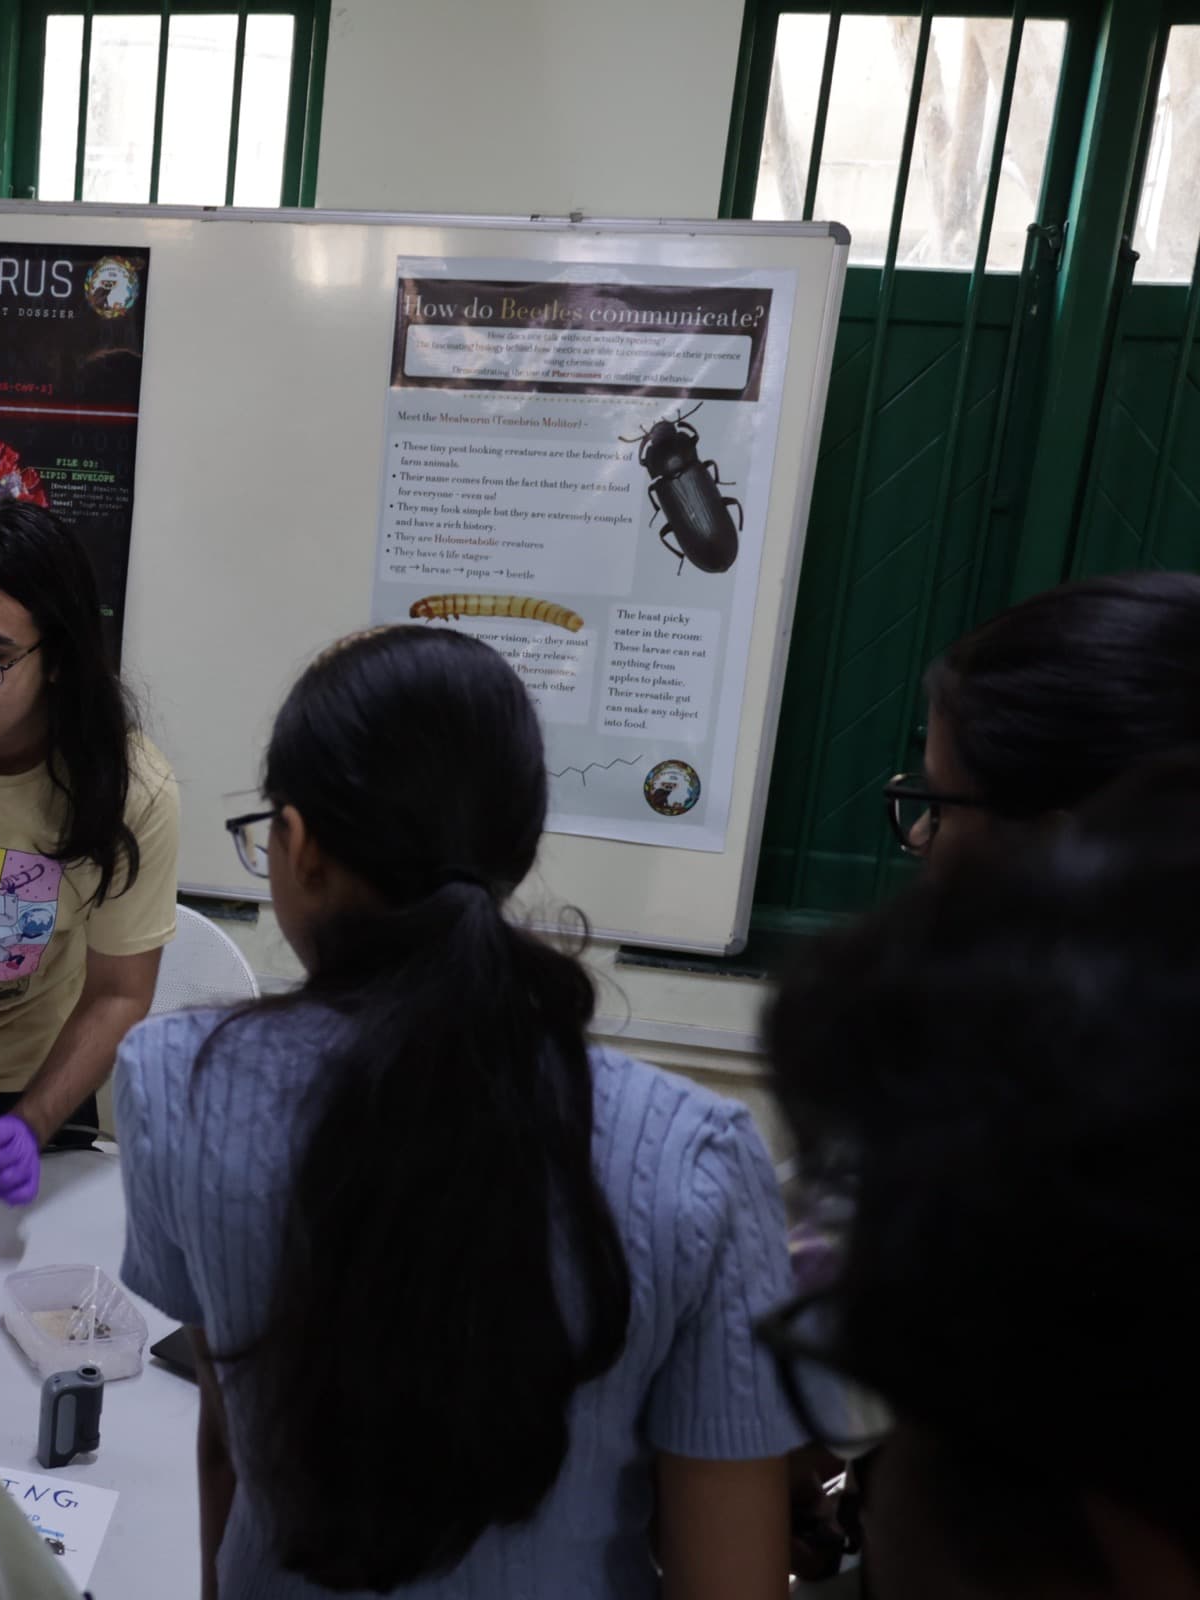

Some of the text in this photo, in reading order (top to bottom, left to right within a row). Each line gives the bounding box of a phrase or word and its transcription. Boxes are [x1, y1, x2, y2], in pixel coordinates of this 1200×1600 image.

[19, 307, 75, 319] DOSSIER
[405, 295, 764, 328] How do Beetles communicate?
[398, 410, 420, 421] Meet
[422, 412, 437, 422] the
[439, 413, 490, 424] Mealworm
[402, 441, 428, 450] These
[430, 444, 447, 455] tiny
[449, 446, 467, 455] pest
[470, 445, 503, 458] looking
[505, 448, 548, 457] creatures
[566, 450, 581, 458] the
[56, 458, 79, 467] FILE
[400, 456, 422, 465] farm
[40, 471, 116, 483] LIPID ENVELOPE
[400, 472, 424, 481] Their
[426, 475, 450, 483] name
[482, 476, 504, 486] from
[506, 477, 520, 486] the
[521, 477, 538, 487] fact
[540, 479, 558, 489] that
[560, 480, 578, 492] they
[608, 482, 631, 493] food
[398, 487, 411, 496] for
[413, 490, 453, 500] everyone
[397, 502, 418, 514] They
[420, 505, 438, 515] may
[440, 504, 460, 514] look
[462, 506, 492, 517] simple
[494, 507, 508, 517] but
[510, 508, 529, 520] they
[547, 512, 592, 524] extremely
[395, 518, 413, 526] and
[414, 518, 434, 527] have
[443, 520, 462, 529] rich
[464, 521, 496, 532] history.
[394, 531, 416, 544] They
[435, 534, 499, 547] Holometabolic
[501, 540, 544, 549] creatures
[393, 546, 414, 558] They
[417, 549, 436, 558] have
[446, 550, 460, 559] life
[390, 564, 535, 580] egg larvae pupa beetle
[617, 609, 690, 626] The least picky
[476, 633, 499, 642] poor
[501, 633, 531, 645] vision,
[544, 636, 564, 646] they
[566, 639, 589, 647] must
[614, 628, 641, 637] eater
[642, 629, 652, 638] in
[654, 629, 671, 639] the
[522, 651, 541, 661] they
[613, 642, 640, 652] These
[642, 644, 672, 655] larvae
[692, 649, 706, 658] eat
[611, 658, 676, 671] anything from
[609, 673, 639, 685] apples
[641, 675, 651, 684] to
[527, 681, 576, 693] each other
[608, 687, 691, 705] Their versatile gut
[606, 704, 698, 720] can make any object
[604, 718, 623, 728] into
